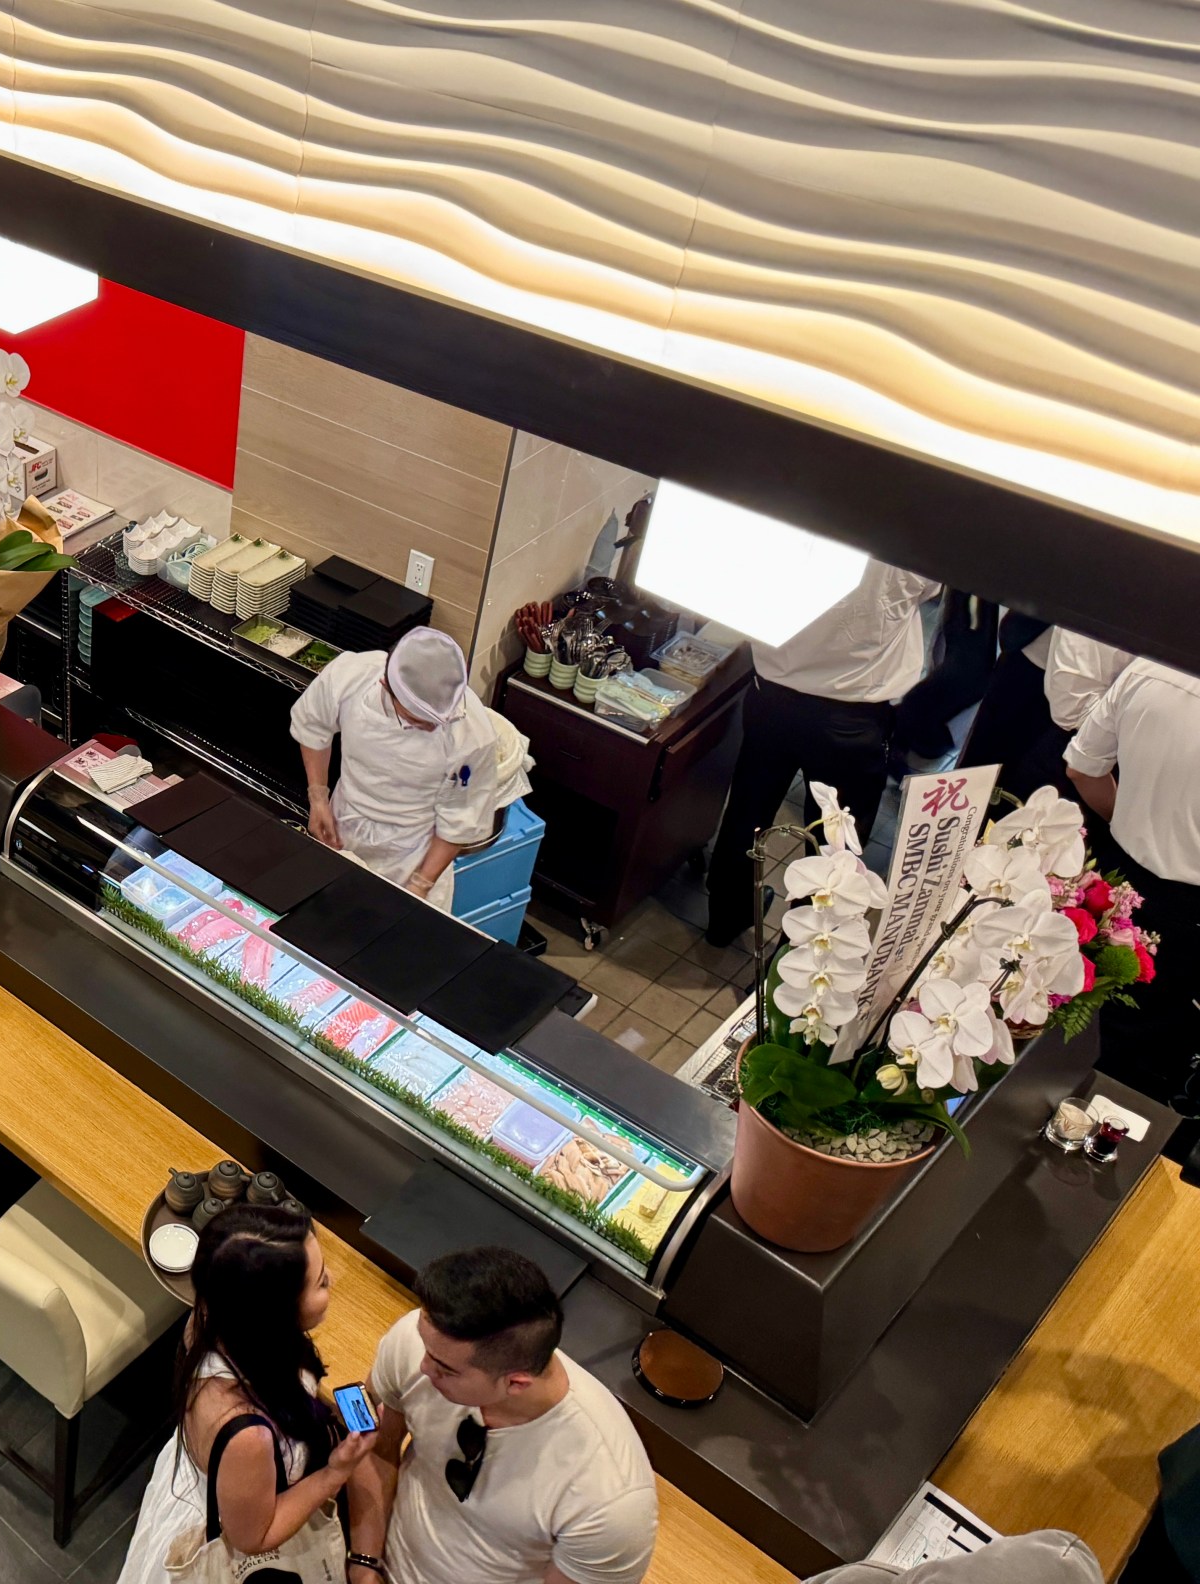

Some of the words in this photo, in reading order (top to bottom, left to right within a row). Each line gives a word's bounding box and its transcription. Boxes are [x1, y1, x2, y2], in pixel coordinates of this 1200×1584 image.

[921, 777, 970, 818] 祝
[897, 822, 931, 890] SMBC
[925, 816, 961, 875] Sushi
[947, 805, 978, 879] Congratulations
[899, 874, 943, 946] Zanmai
[934, 890, 946, 912] your
[942, 879, 951, 892] on
[857, 889, 914, 1009] MANUBANK
[235, 1559, 263, 1580] CANDLE
